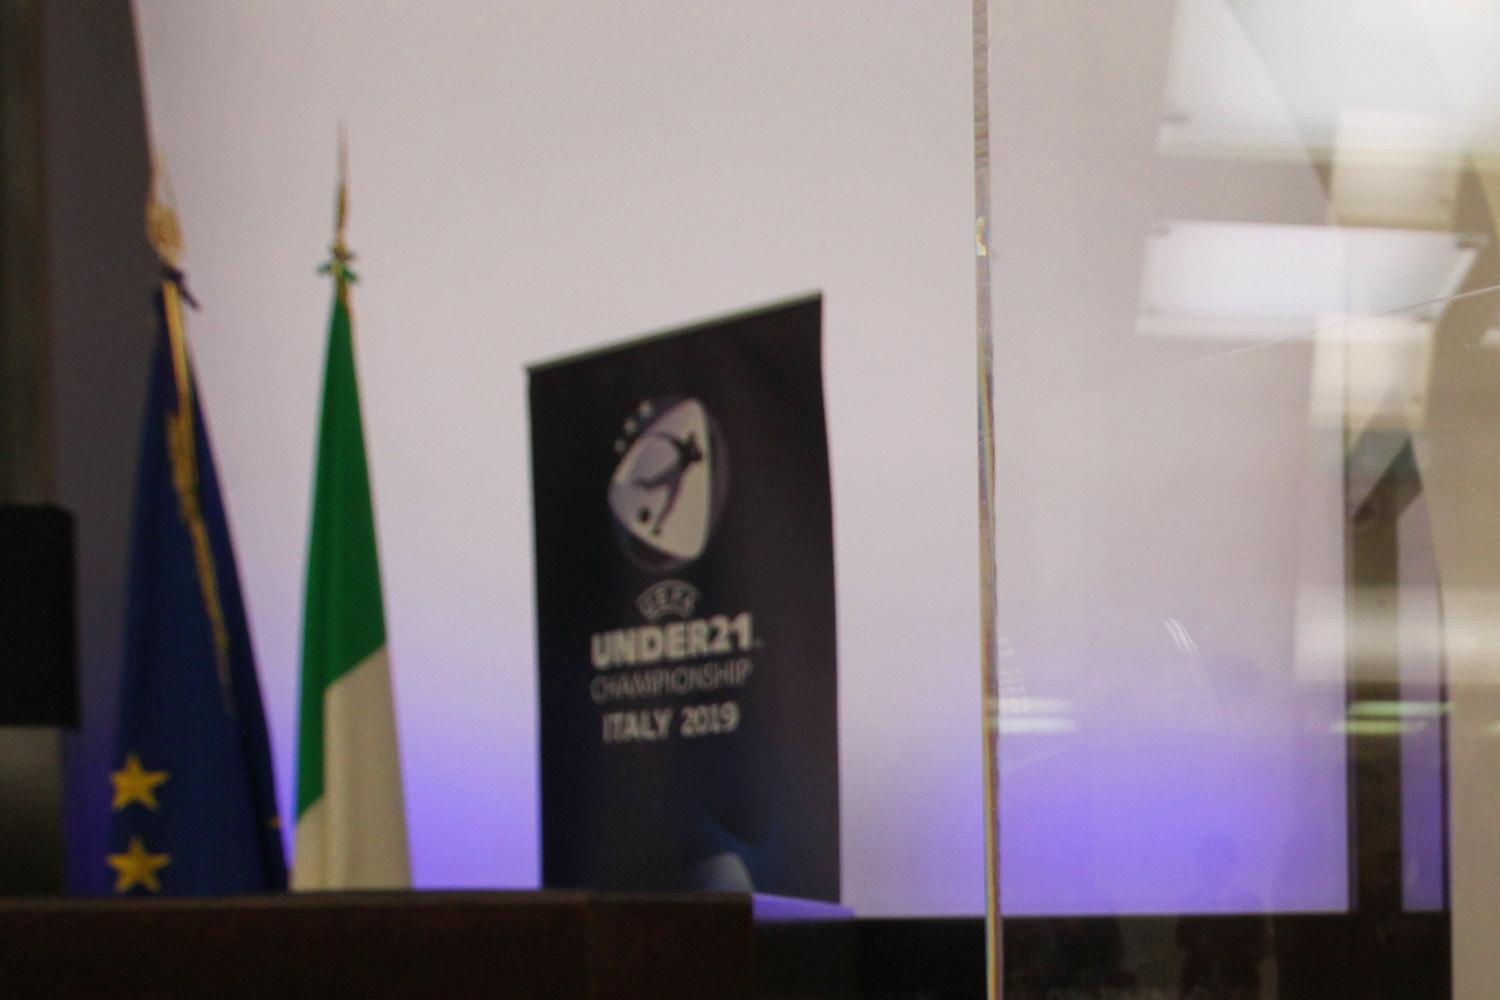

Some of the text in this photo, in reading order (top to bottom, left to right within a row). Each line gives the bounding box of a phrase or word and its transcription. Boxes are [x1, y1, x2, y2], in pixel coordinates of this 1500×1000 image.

[590, 611, 753, 671] UNDER21
[589, 656, 753, 704] CHAMPIONSHIP
[602, 700, 741, 744] ITALY 2019
